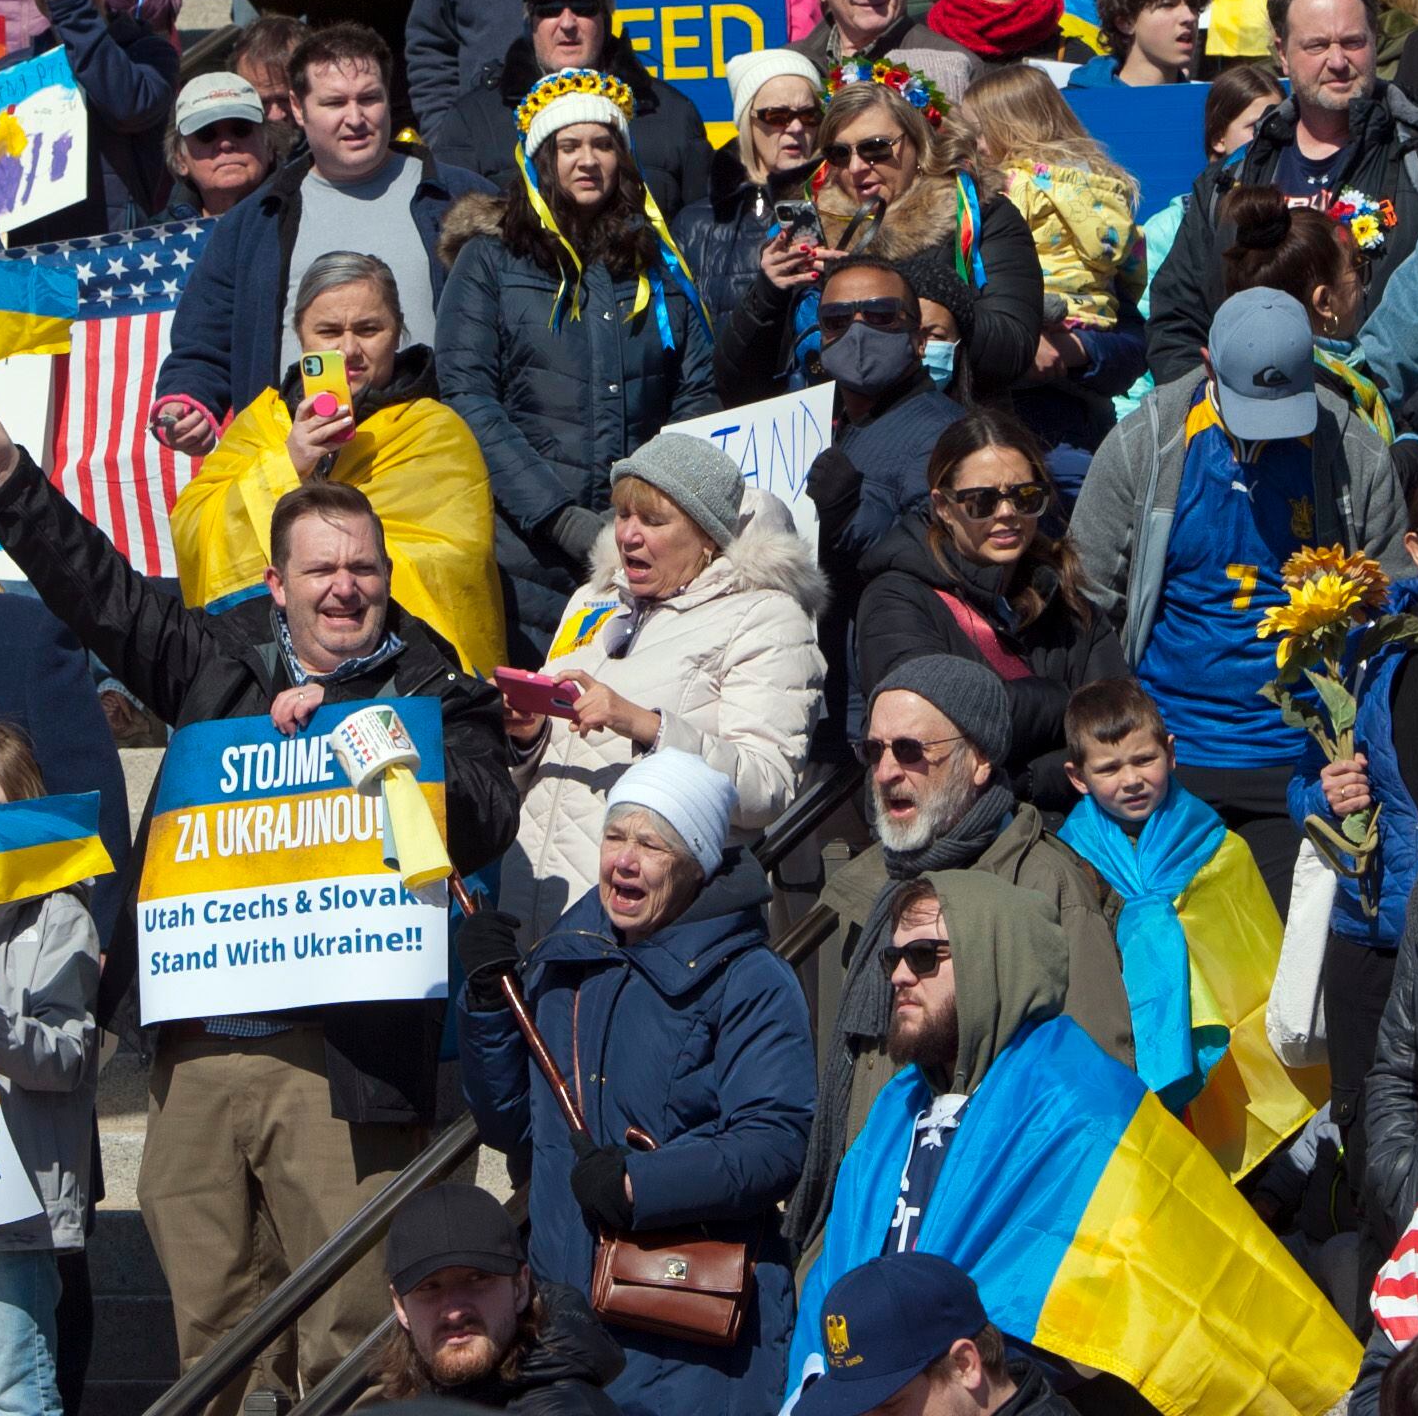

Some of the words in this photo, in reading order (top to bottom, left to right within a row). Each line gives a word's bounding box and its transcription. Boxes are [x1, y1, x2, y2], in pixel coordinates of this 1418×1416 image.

[610, 2, 766, 81] EED
[710, 399, 824, 504] TAND
[174, 813, 210, 863] ZA
[217, 793, 384, 859] UKRAJINOU!
[145, 902, 195, 933] Utah
[202, 893, 288, 925] Czechs
[294, 889, 312, 914] &
[318, 880, 418, 911] Slovak
[150, 943, 218, 976] Stand
[226, 932, 286, 967] With
[293, 926, 423, 960] Ukraine!!
